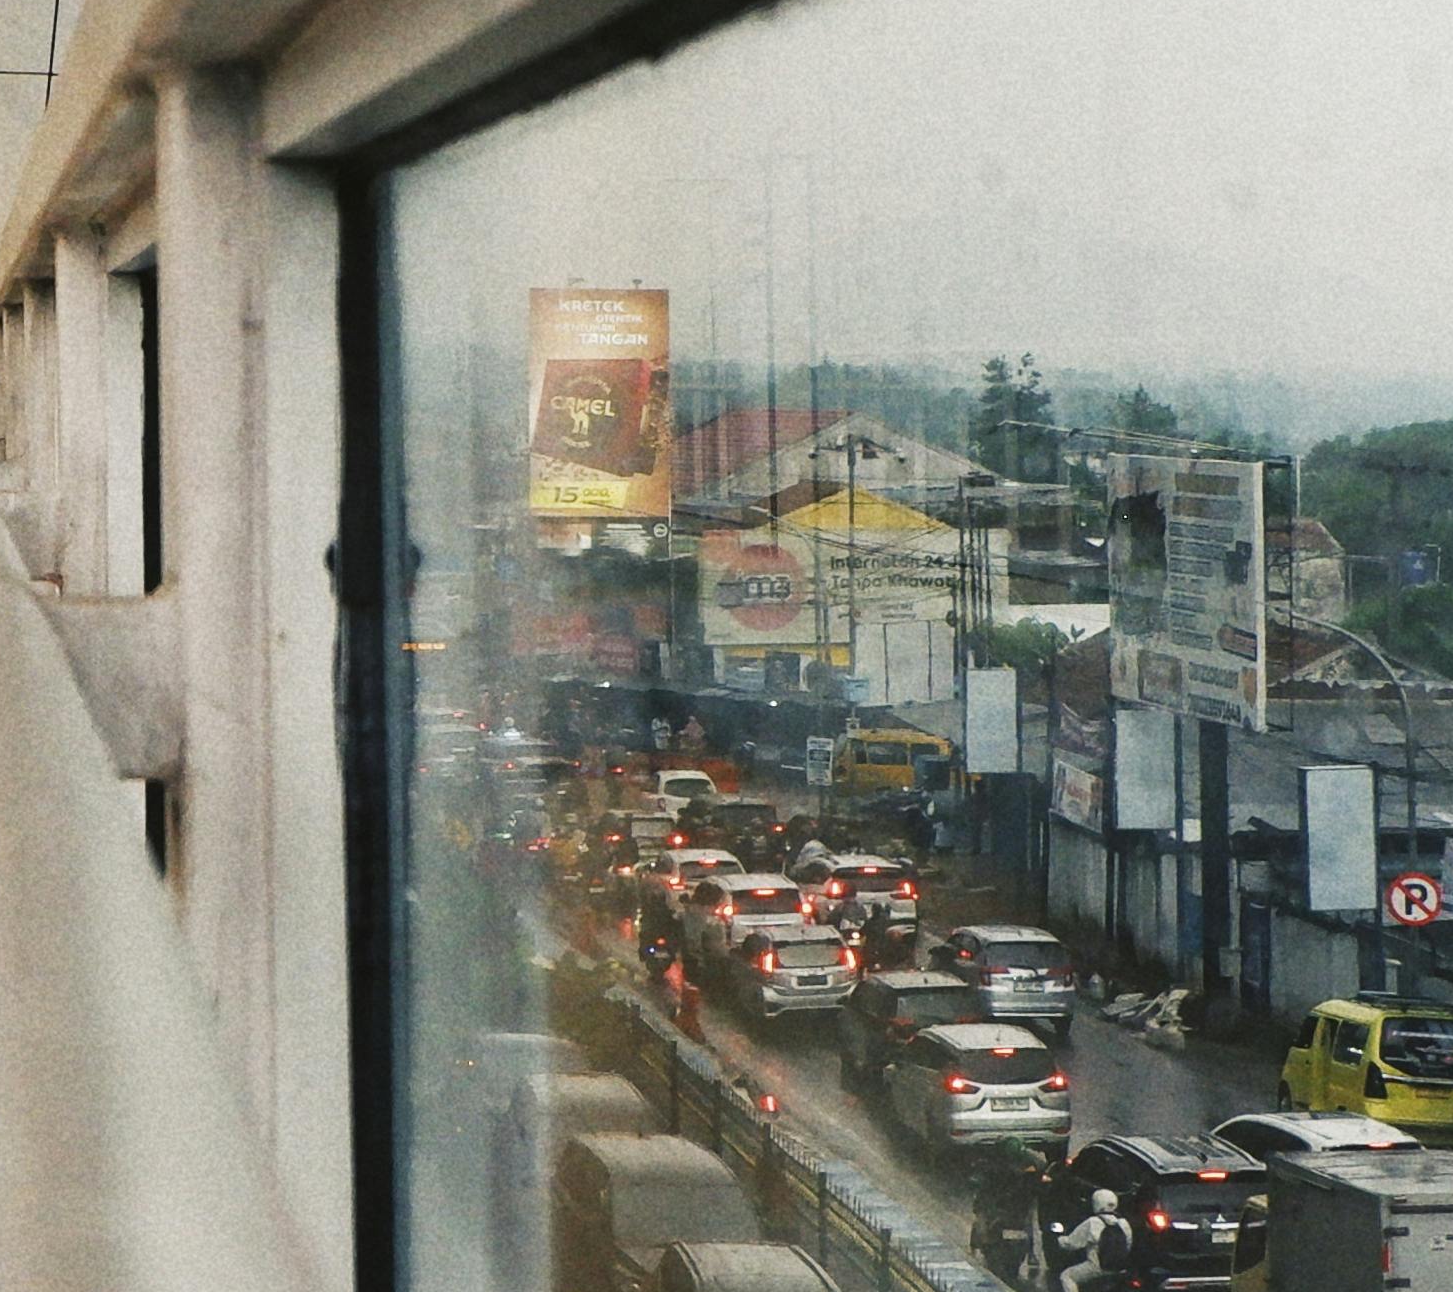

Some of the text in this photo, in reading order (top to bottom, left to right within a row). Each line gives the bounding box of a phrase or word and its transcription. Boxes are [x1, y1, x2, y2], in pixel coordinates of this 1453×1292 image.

[558, 299, 625, 313] KRETEK
[579, 333, 649, 346] TANGAN
[550, 395, 616, 419] CAMEL
